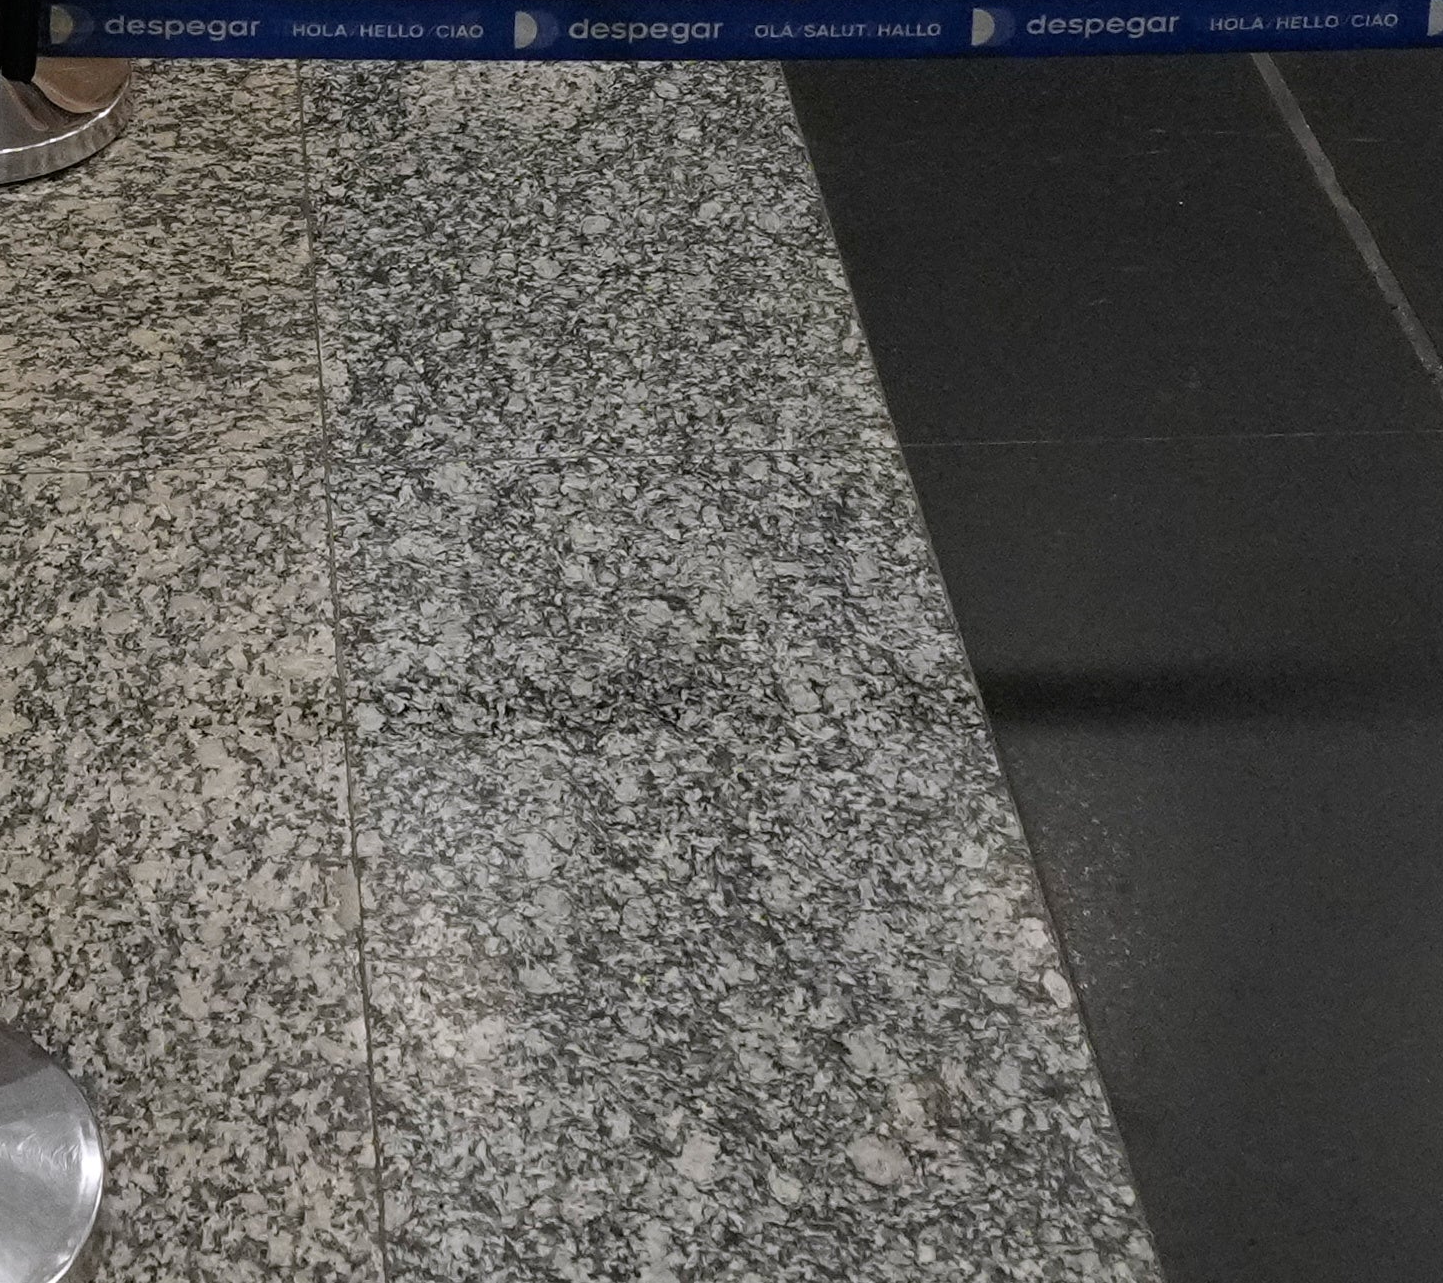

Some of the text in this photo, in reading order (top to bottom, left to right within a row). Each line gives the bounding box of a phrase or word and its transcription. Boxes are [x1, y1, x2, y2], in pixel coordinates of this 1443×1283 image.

[104, 14, 260, 42] despegar
[568, 18, 723, 44] despegar
[1027, 14, 1180, 39] despegar
